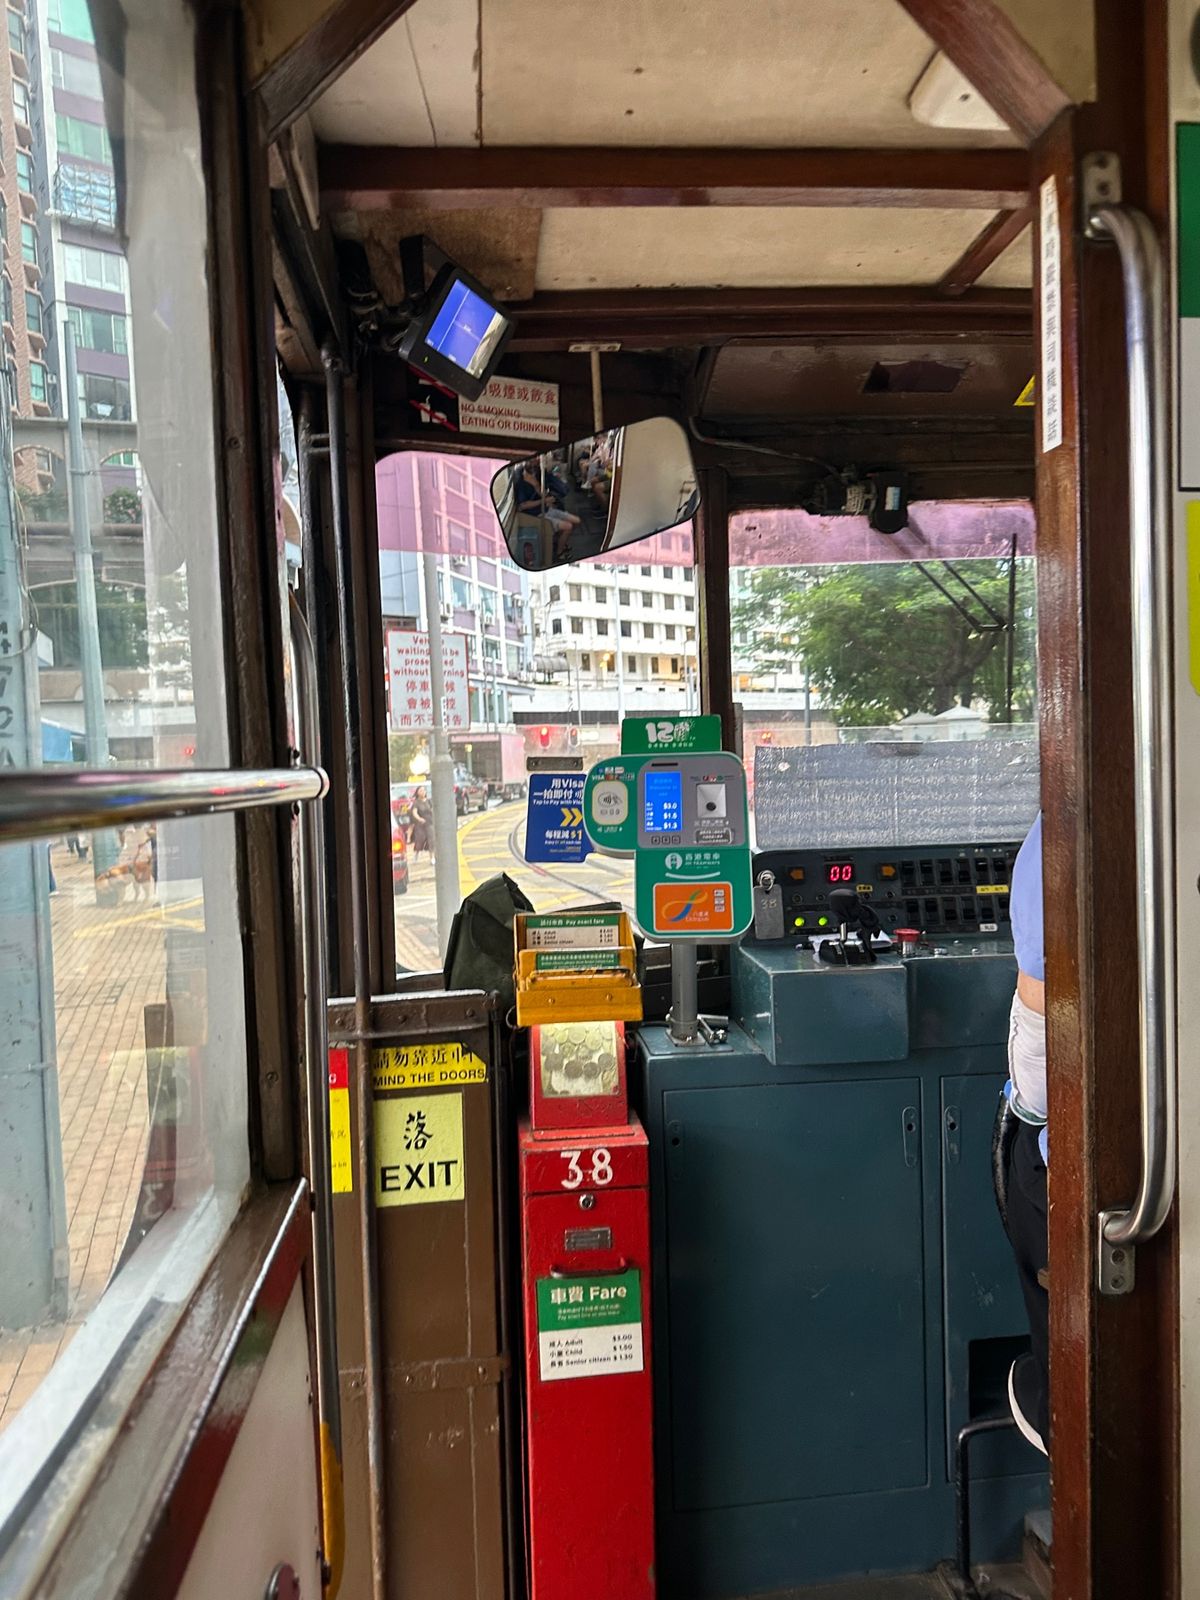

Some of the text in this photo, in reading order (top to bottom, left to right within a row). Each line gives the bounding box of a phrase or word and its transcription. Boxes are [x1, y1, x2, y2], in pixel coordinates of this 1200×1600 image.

[461, 403, 521, 418] NO SMOKING
[461, 416, 557, 436] EATING OR DRINKING
[394, 668, 464, 678] without rning
[406, 681, 455, 692] 停車候
[407, 698, 456, 710] 會被控
[830, 865, 852, 882] 00
[374, 1068, 485, 1086] MIND THE DOORS
[403, 1110, 433, 1151] 落
[380, 1160, 458, 1193] EXIT
[560, 1147, 613, 1189] 38
[589, 1286, 627, 1301] Fare
